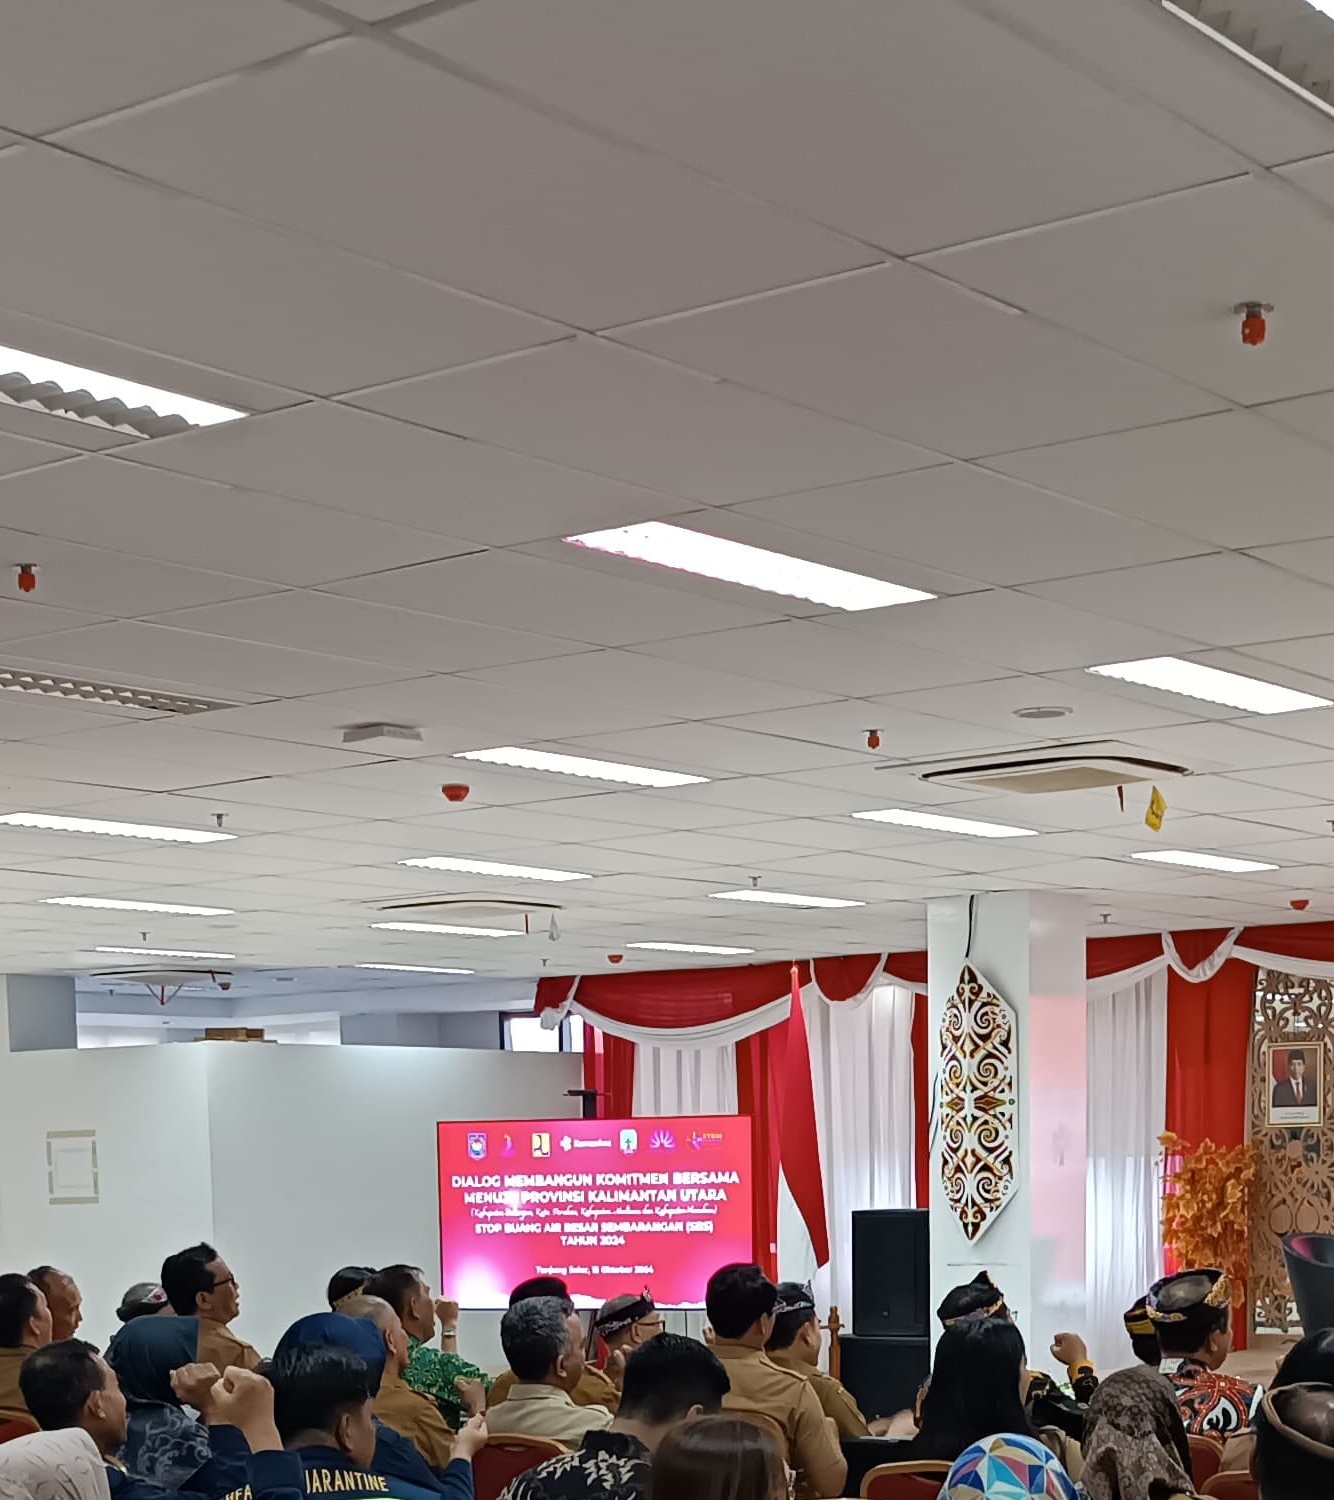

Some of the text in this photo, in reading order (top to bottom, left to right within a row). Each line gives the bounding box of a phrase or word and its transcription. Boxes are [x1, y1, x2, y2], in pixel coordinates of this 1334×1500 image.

[451, 1175, 501, 1188] DIALOG
[673, 1171, 740, 1184] BERSAMA
[521, 1190, 585, 1204] PROVINSI
[680, 1188, 728, 1202] UTARA
